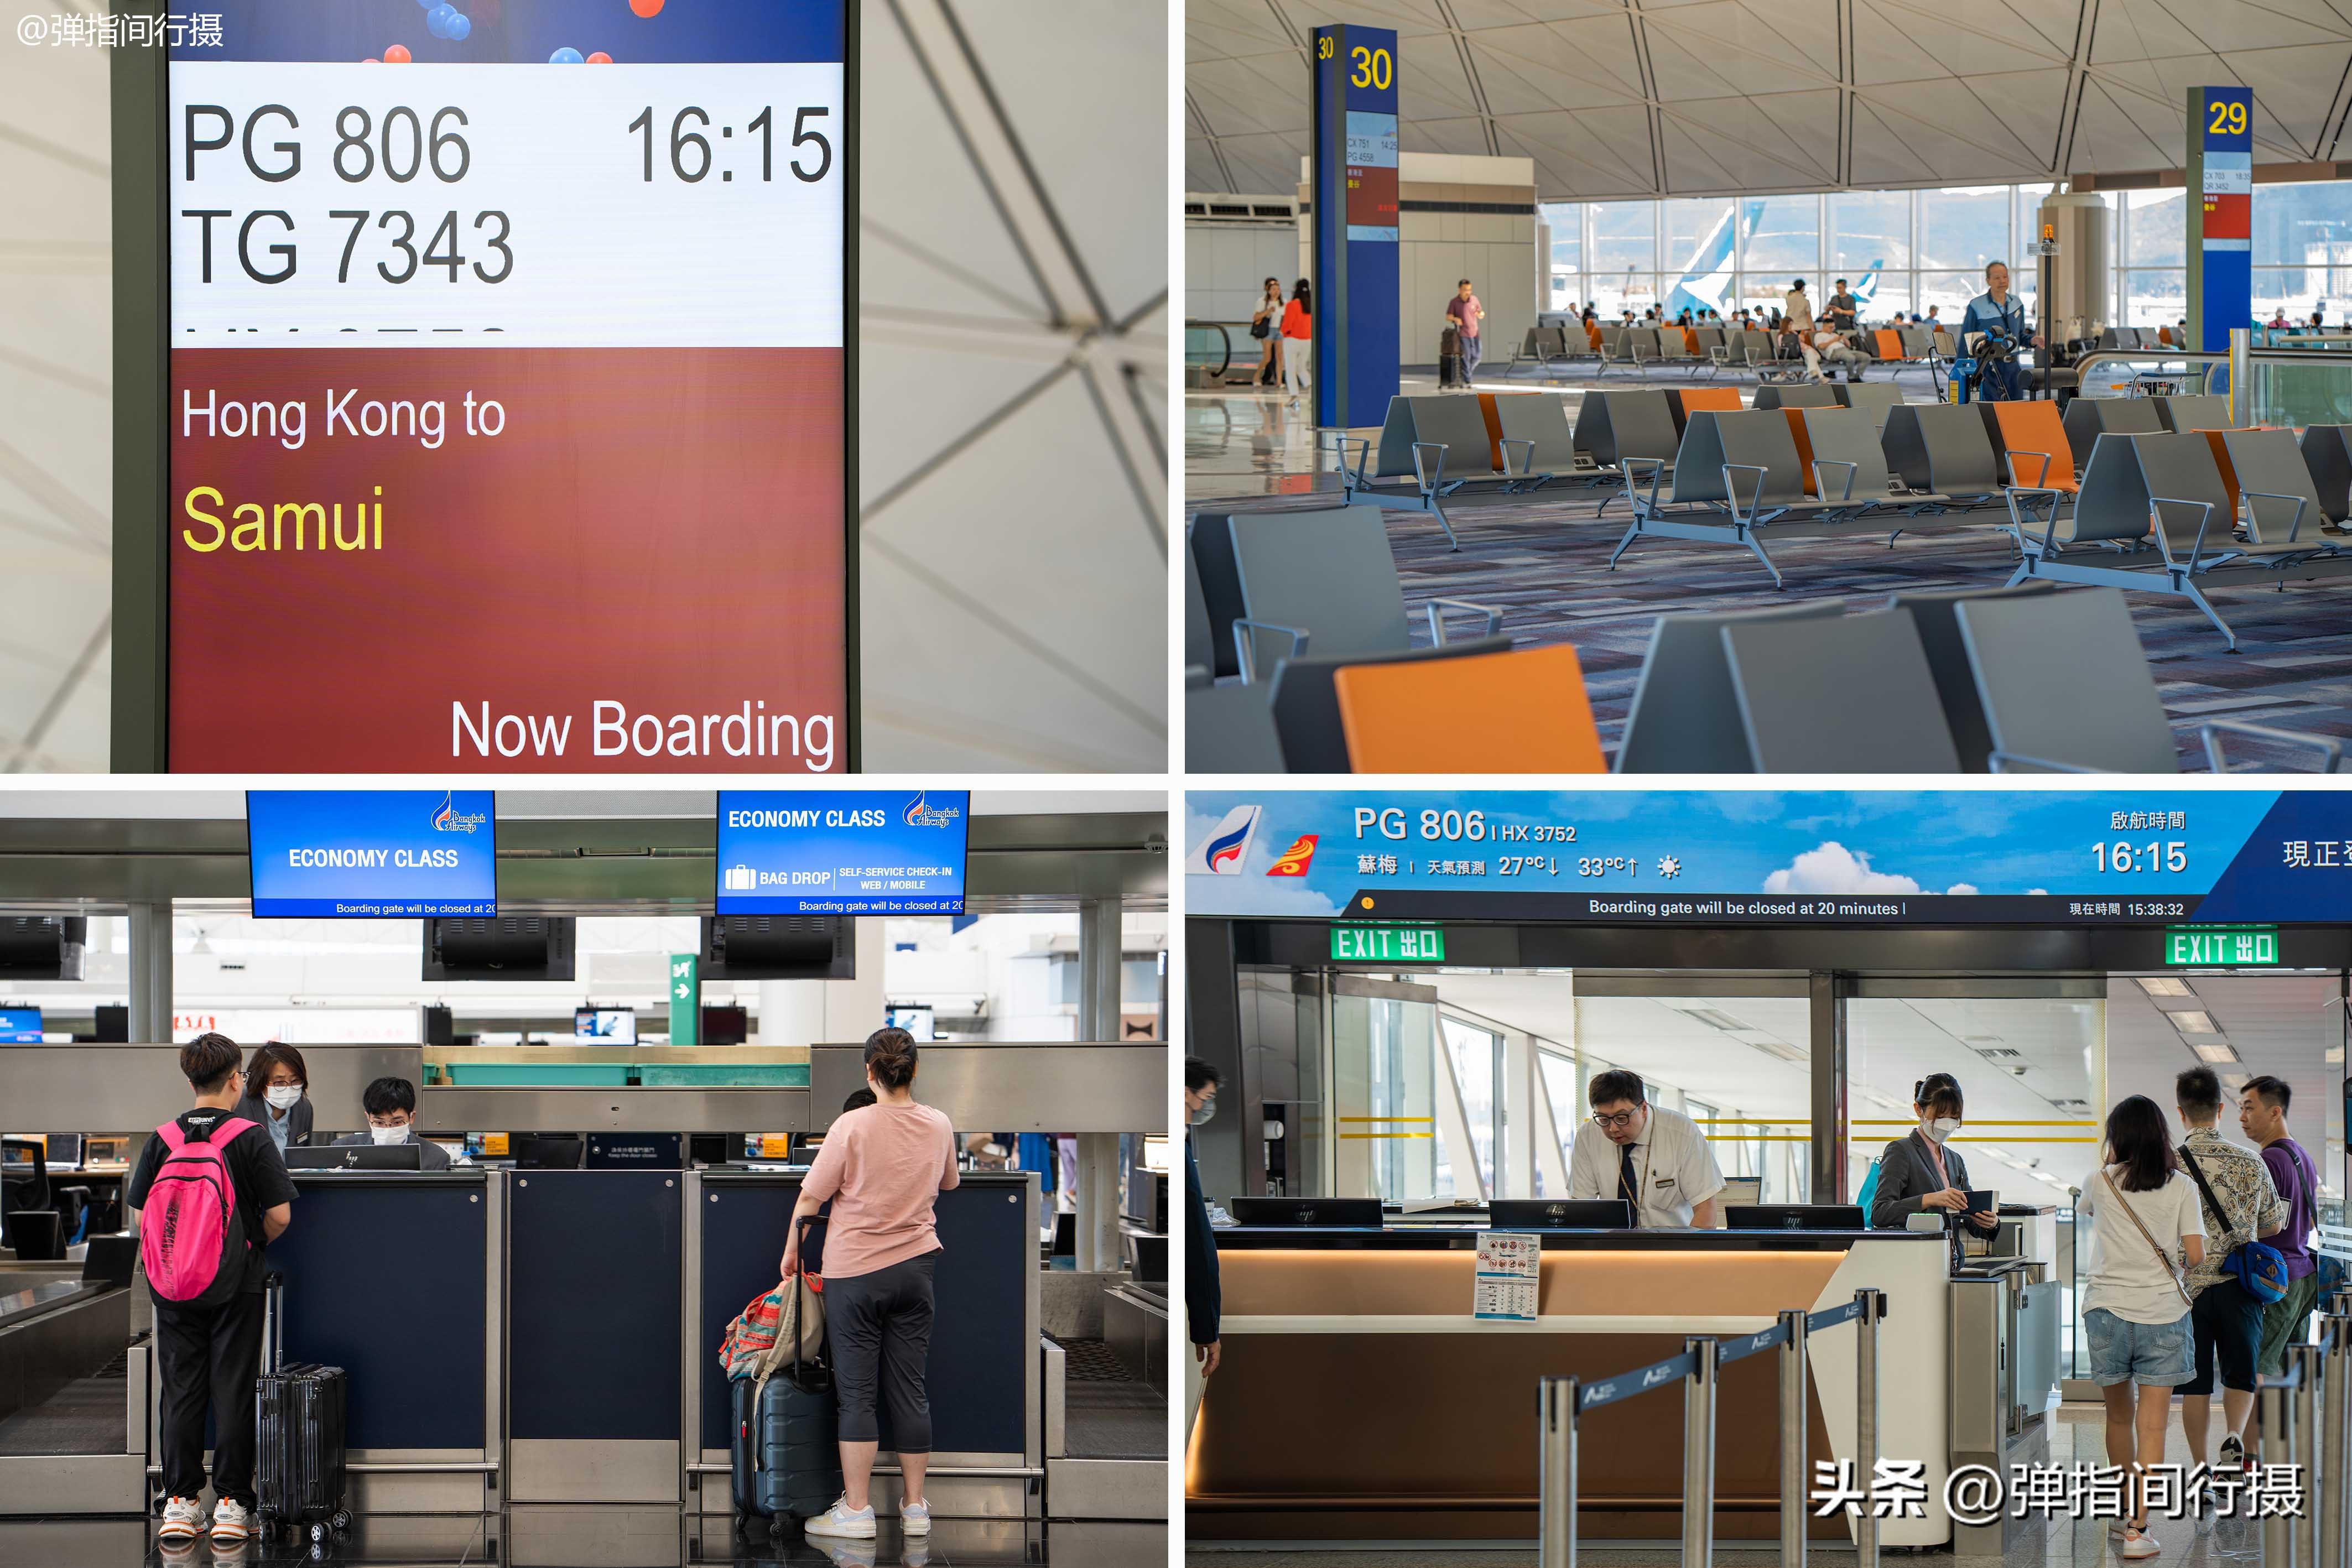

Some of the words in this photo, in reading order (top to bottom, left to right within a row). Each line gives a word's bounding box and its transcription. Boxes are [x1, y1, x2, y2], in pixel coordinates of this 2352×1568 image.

[1319, 36, 1334, 60] 30
[1351, 46, 1392, 90] 30
[2209, 101, 2247, 135] 29
[184, 104, 303, 183] PG
[333, 105, 471, 183] 806
[628, 105, 832, 183] 16:15
[1347, 152, 1358, 161] PG
[181, 210, 298, 284] TG
[329, 210, 514, 285] 7343
[183, 388, 306, 449] Hong
[327, 388, 446, 449] Kong
[464, 390, 506, 437] to
[183, 486, 383, 553] Samui
[452, 700, 572, 758] Now
[592, 700, 835, 772] Boarding
[452, 811, 486, 825] Bangkok
[729, 810, 821, 827] ECONOMY
[826, 810, 885, 827] CLASS
[926, 806, 959, 819] Bangkok
[2111, 811, 2186, 830] 啟航時間
[446, 821, 477, 834] Airways
[917, 816, 950, 829] Airways
[1355, 808, 1406, 840] PG
[1420, 809, 1486, 841] 806
[1502, 826, 1529, 841] HX
[1534, 826, 1576, 842] 3752
[289, 849, 388, 868] ECONOMY
[394, 849, 459, 867] CLASS
[1357, 855, 1397, 874] 蘇梅
[2092, 842, 2187, 872] 16:15
[839, 867, 905, 877] SELF-SERVICE
[907, 867, 952, 876] CHECK-IN
[1428, 860, 1486, 876] 天氣預測
[760, 872, 788, 885] BAG
[792, 872, 831, 885] DROP
[861, 881, 881, 890] WEB
[890, 881, 925, 889] MOBILE
[336, 904, 380, 914] Boarding
[383, 906, 404, 915] gate
[407, 904, 422, 913] will
[424, 904, 437, 913] be
[439, 904, 471, 913] closed
[799, 901, 844, 912] Boarding
[846, 903, 868, 912] gate
[871, 901, 886, 910] will
[889, 901, 902, 910] be
[904, 901, 936, 910] closed
[939, 902, 949, 910] at
[1590, 900, 1656, 916] Boarding
[1661, 902, 1693, 916] gate
[1697, 901, 1723, 914] will
[1727, 901, 1745, 914] be
[1749, 902, 1796, 915] closed
[1800, 903, 1814, 914] at
[1818, 902, 1835, 915] 20
[1839, 903, 1898, 915] minutes
[2069, 903, 2120, 916] 現在時間
[2128, 903, 2184, 916] 15:38:32
[1338, 930, 1391, 957] EXIT
[1400, 931, 1438, 957] 出口
[2173, 935, 2226, 963] EXIT
[2236, 935, 2272, 962] 出口
